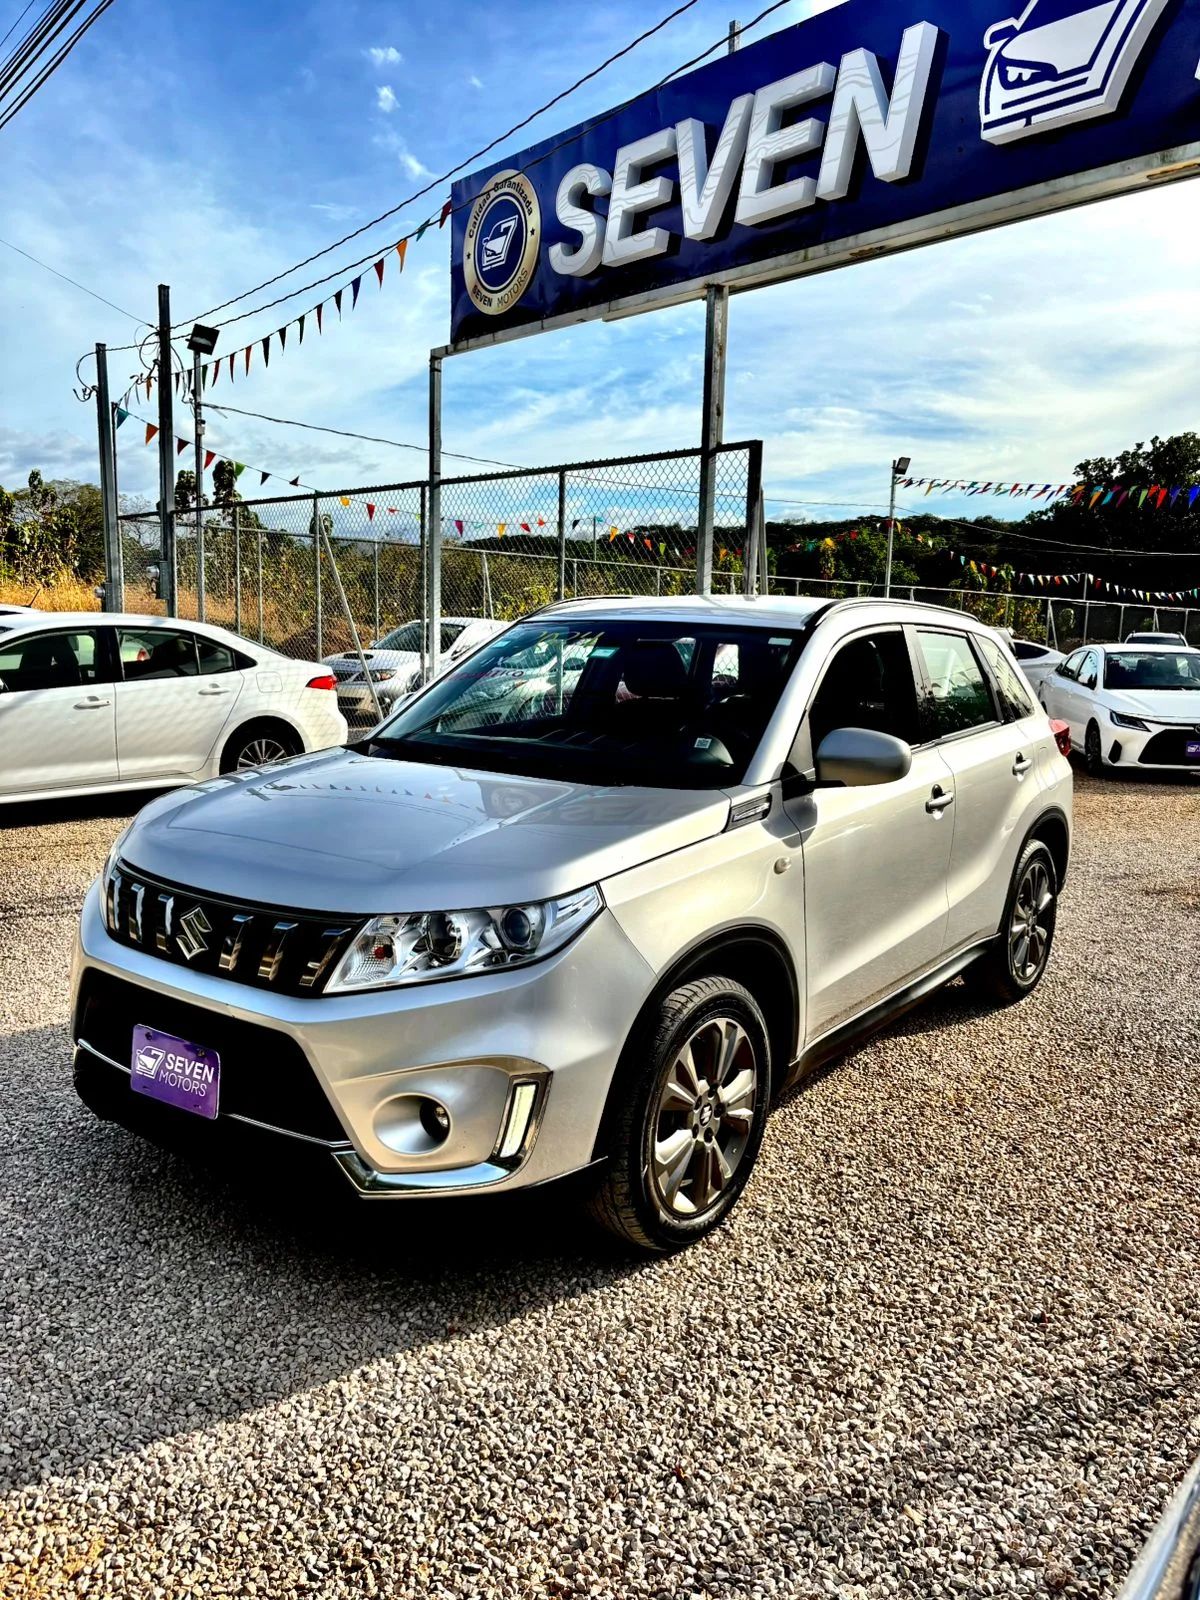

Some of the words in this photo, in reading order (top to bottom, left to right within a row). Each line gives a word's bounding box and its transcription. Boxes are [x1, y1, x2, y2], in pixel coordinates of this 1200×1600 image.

[548, 20, 938, 277] SEVEN
[468, 191, 491, 239] Calidad
[494, 179, 533, 217] Garantizada
[471, 284, 493, 307] SEVEN
[496, 268, 528, 308] MOTORS
[158, 1069, 208, 1097] MOTORS
[165, 1053, 215, 1084] SEVEN
